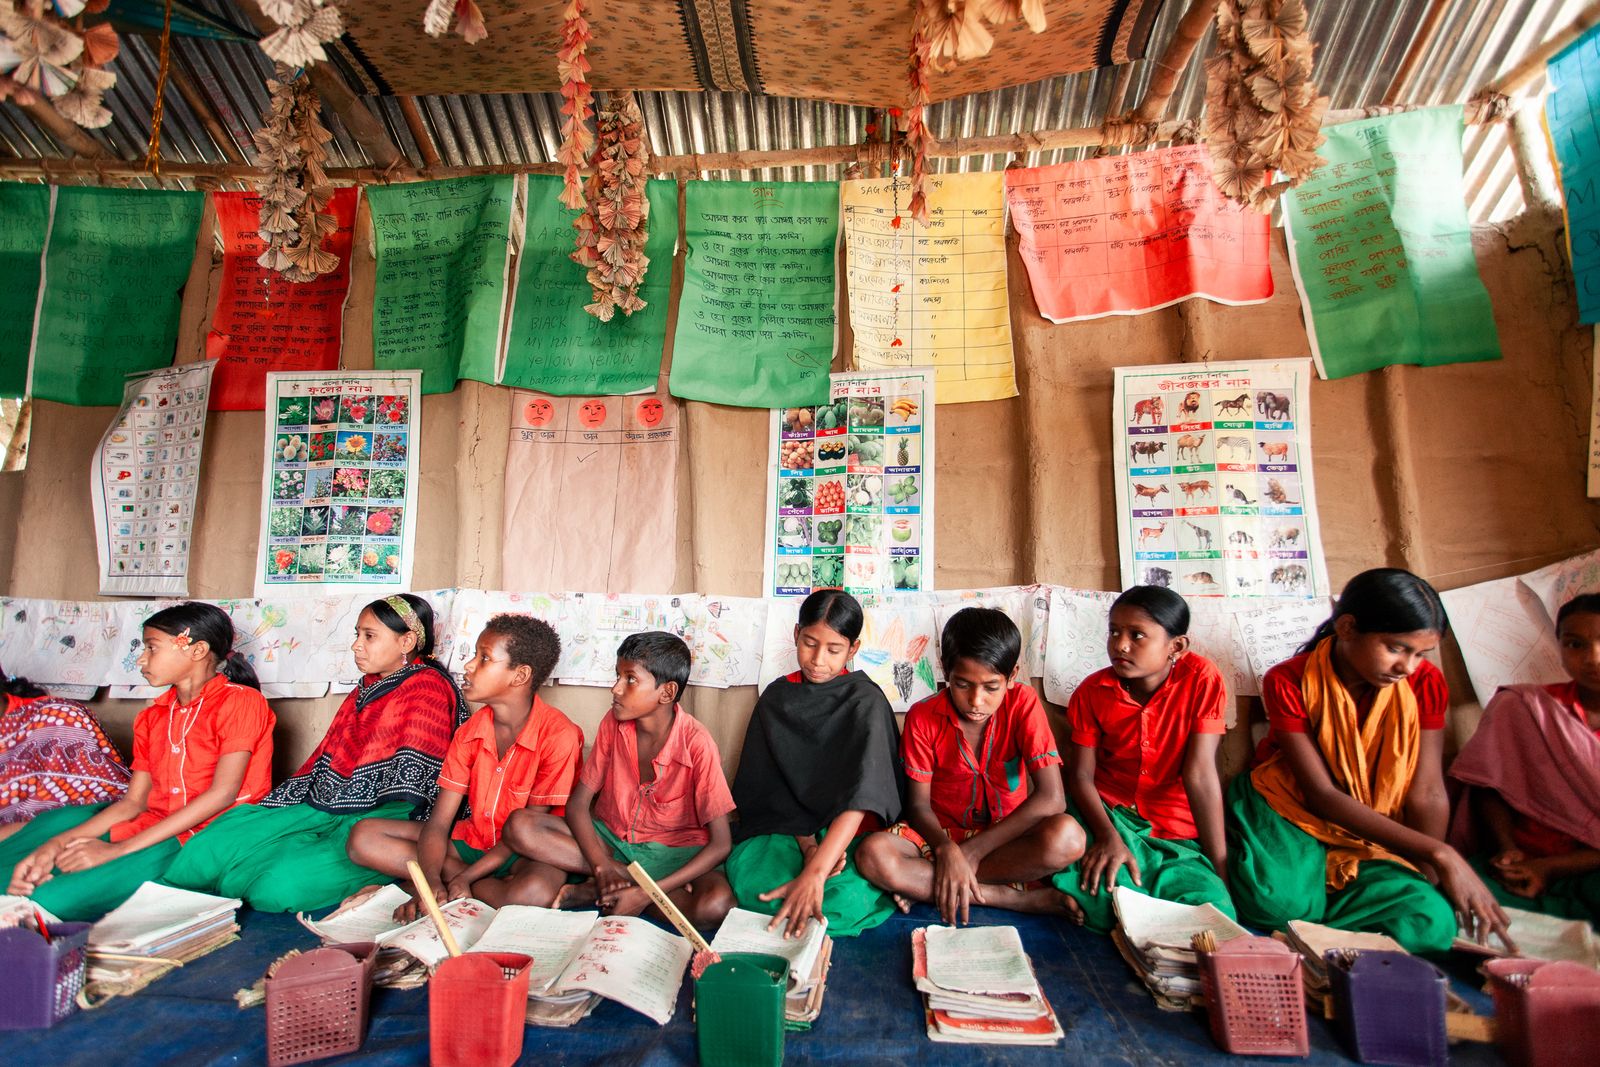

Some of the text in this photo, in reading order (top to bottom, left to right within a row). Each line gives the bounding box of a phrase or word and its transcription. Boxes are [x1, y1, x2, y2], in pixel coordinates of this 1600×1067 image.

[861, 186, 880, 195] SAG
[308, 385, 373, 395] ফুলের নাম
[1157, 379, 1251, 392] জীবজন্তুর নাম
[856, 386, 881, 395] নাম
